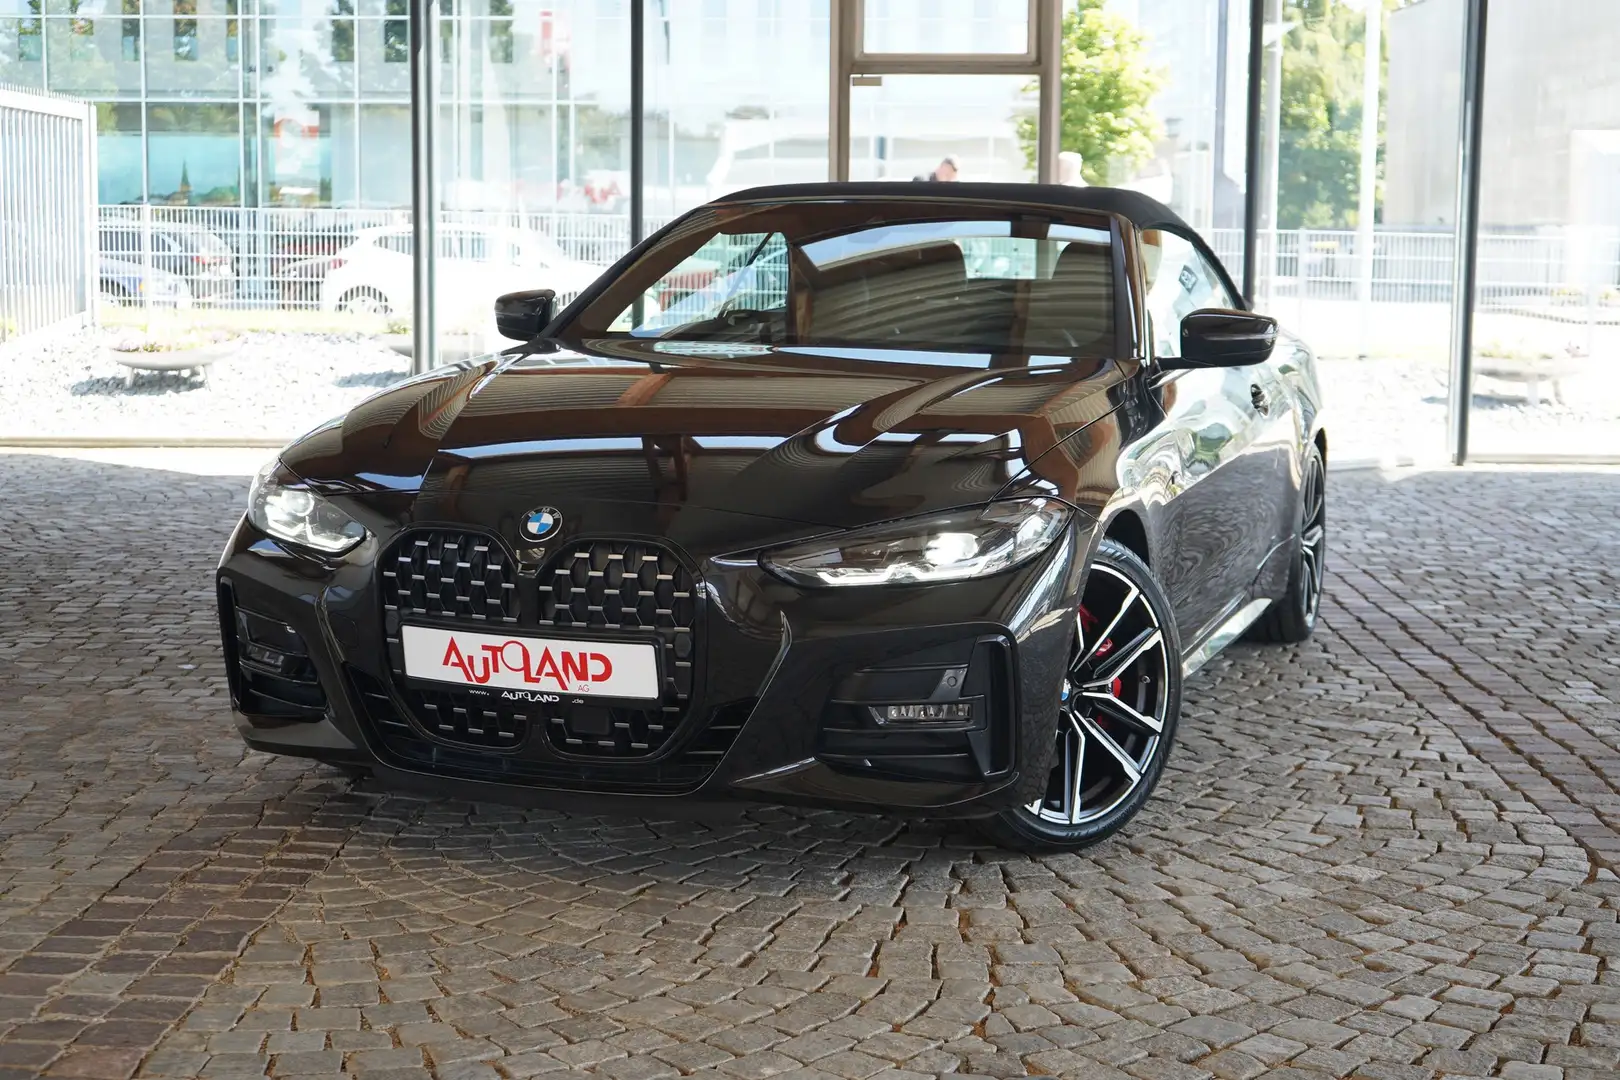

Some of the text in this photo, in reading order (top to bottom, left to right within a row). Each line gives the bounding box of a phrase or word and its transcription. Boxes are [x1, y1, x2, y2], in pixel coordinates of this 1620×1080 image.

[528, 507, 561, 519] BMW
[442, 636, 613, 691] AUTOLAND
[577, 684, 590, 693] AG
[501, 690, 560, 703] AUTOLAND
